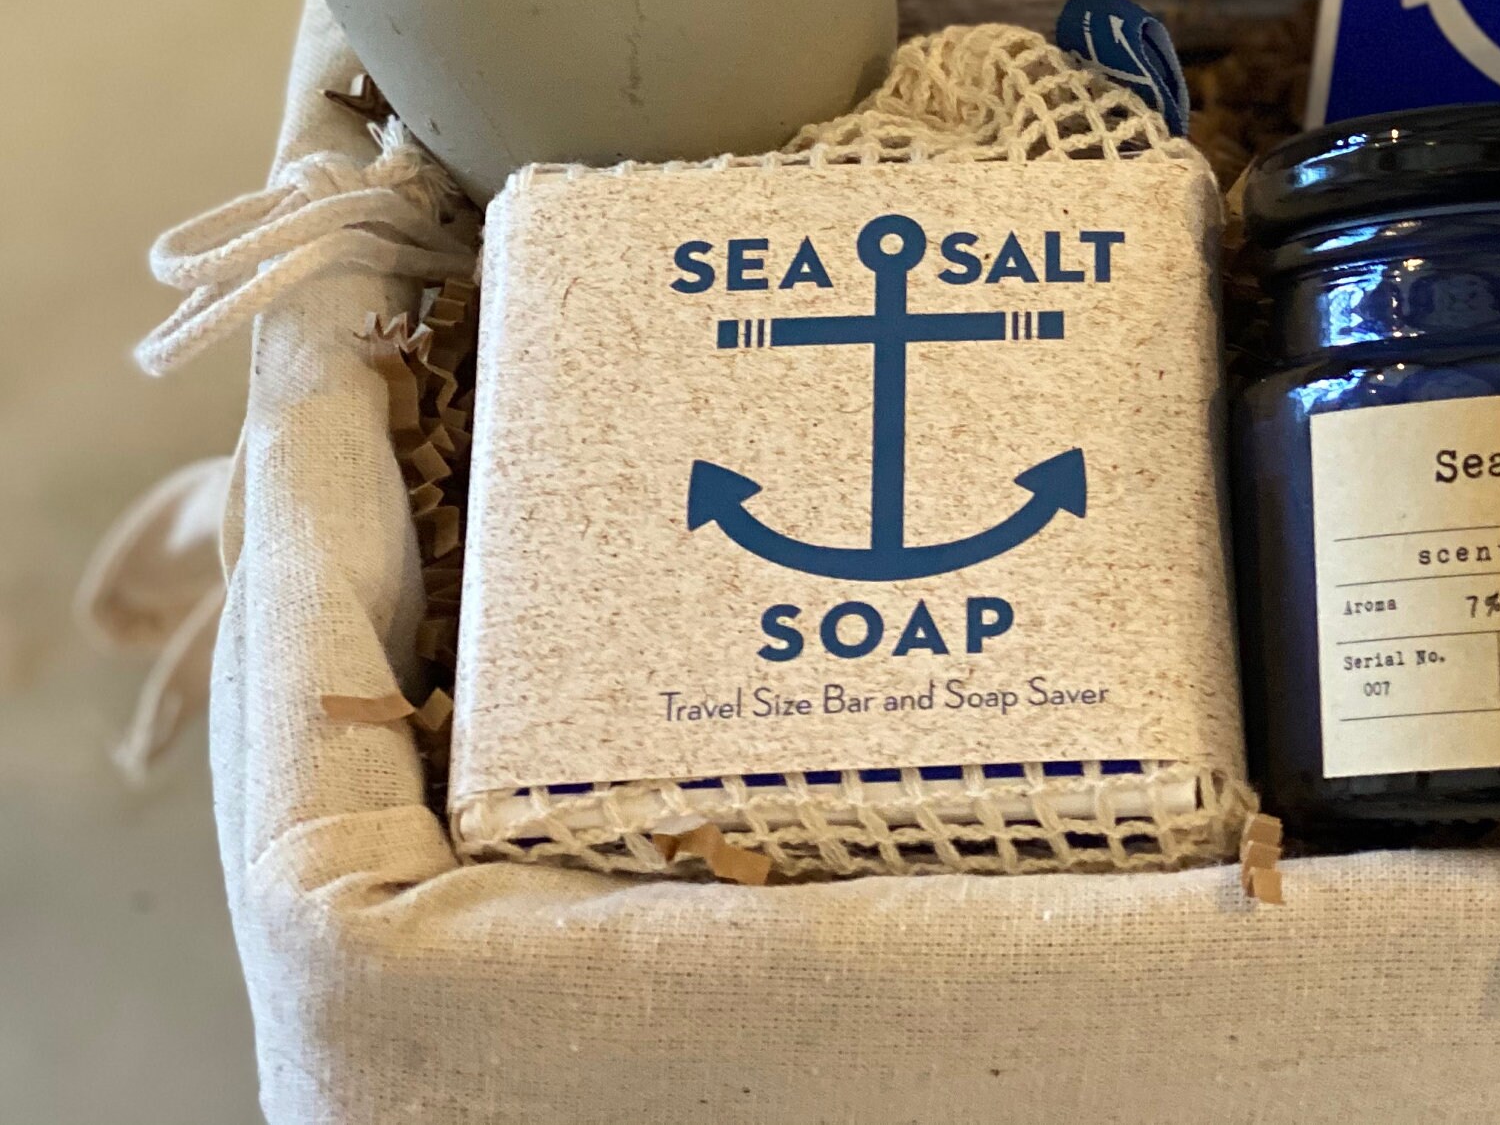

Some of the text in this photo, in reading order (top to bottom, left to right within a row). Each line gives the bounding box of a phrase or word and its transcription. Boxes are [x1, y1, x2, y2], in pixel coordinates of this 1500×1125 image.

[670, 231, 1125, 293] SEA SALT
[1343, 597, 1397, 616] Aroma
[757, 596, 1015, 663] SOAP
[1343, 649, 1446, 671] Serial No.
[660, 676, 1109, 723] Travel Size Bar and Soap Saver
[1364, 681, 1391, 697] 007
